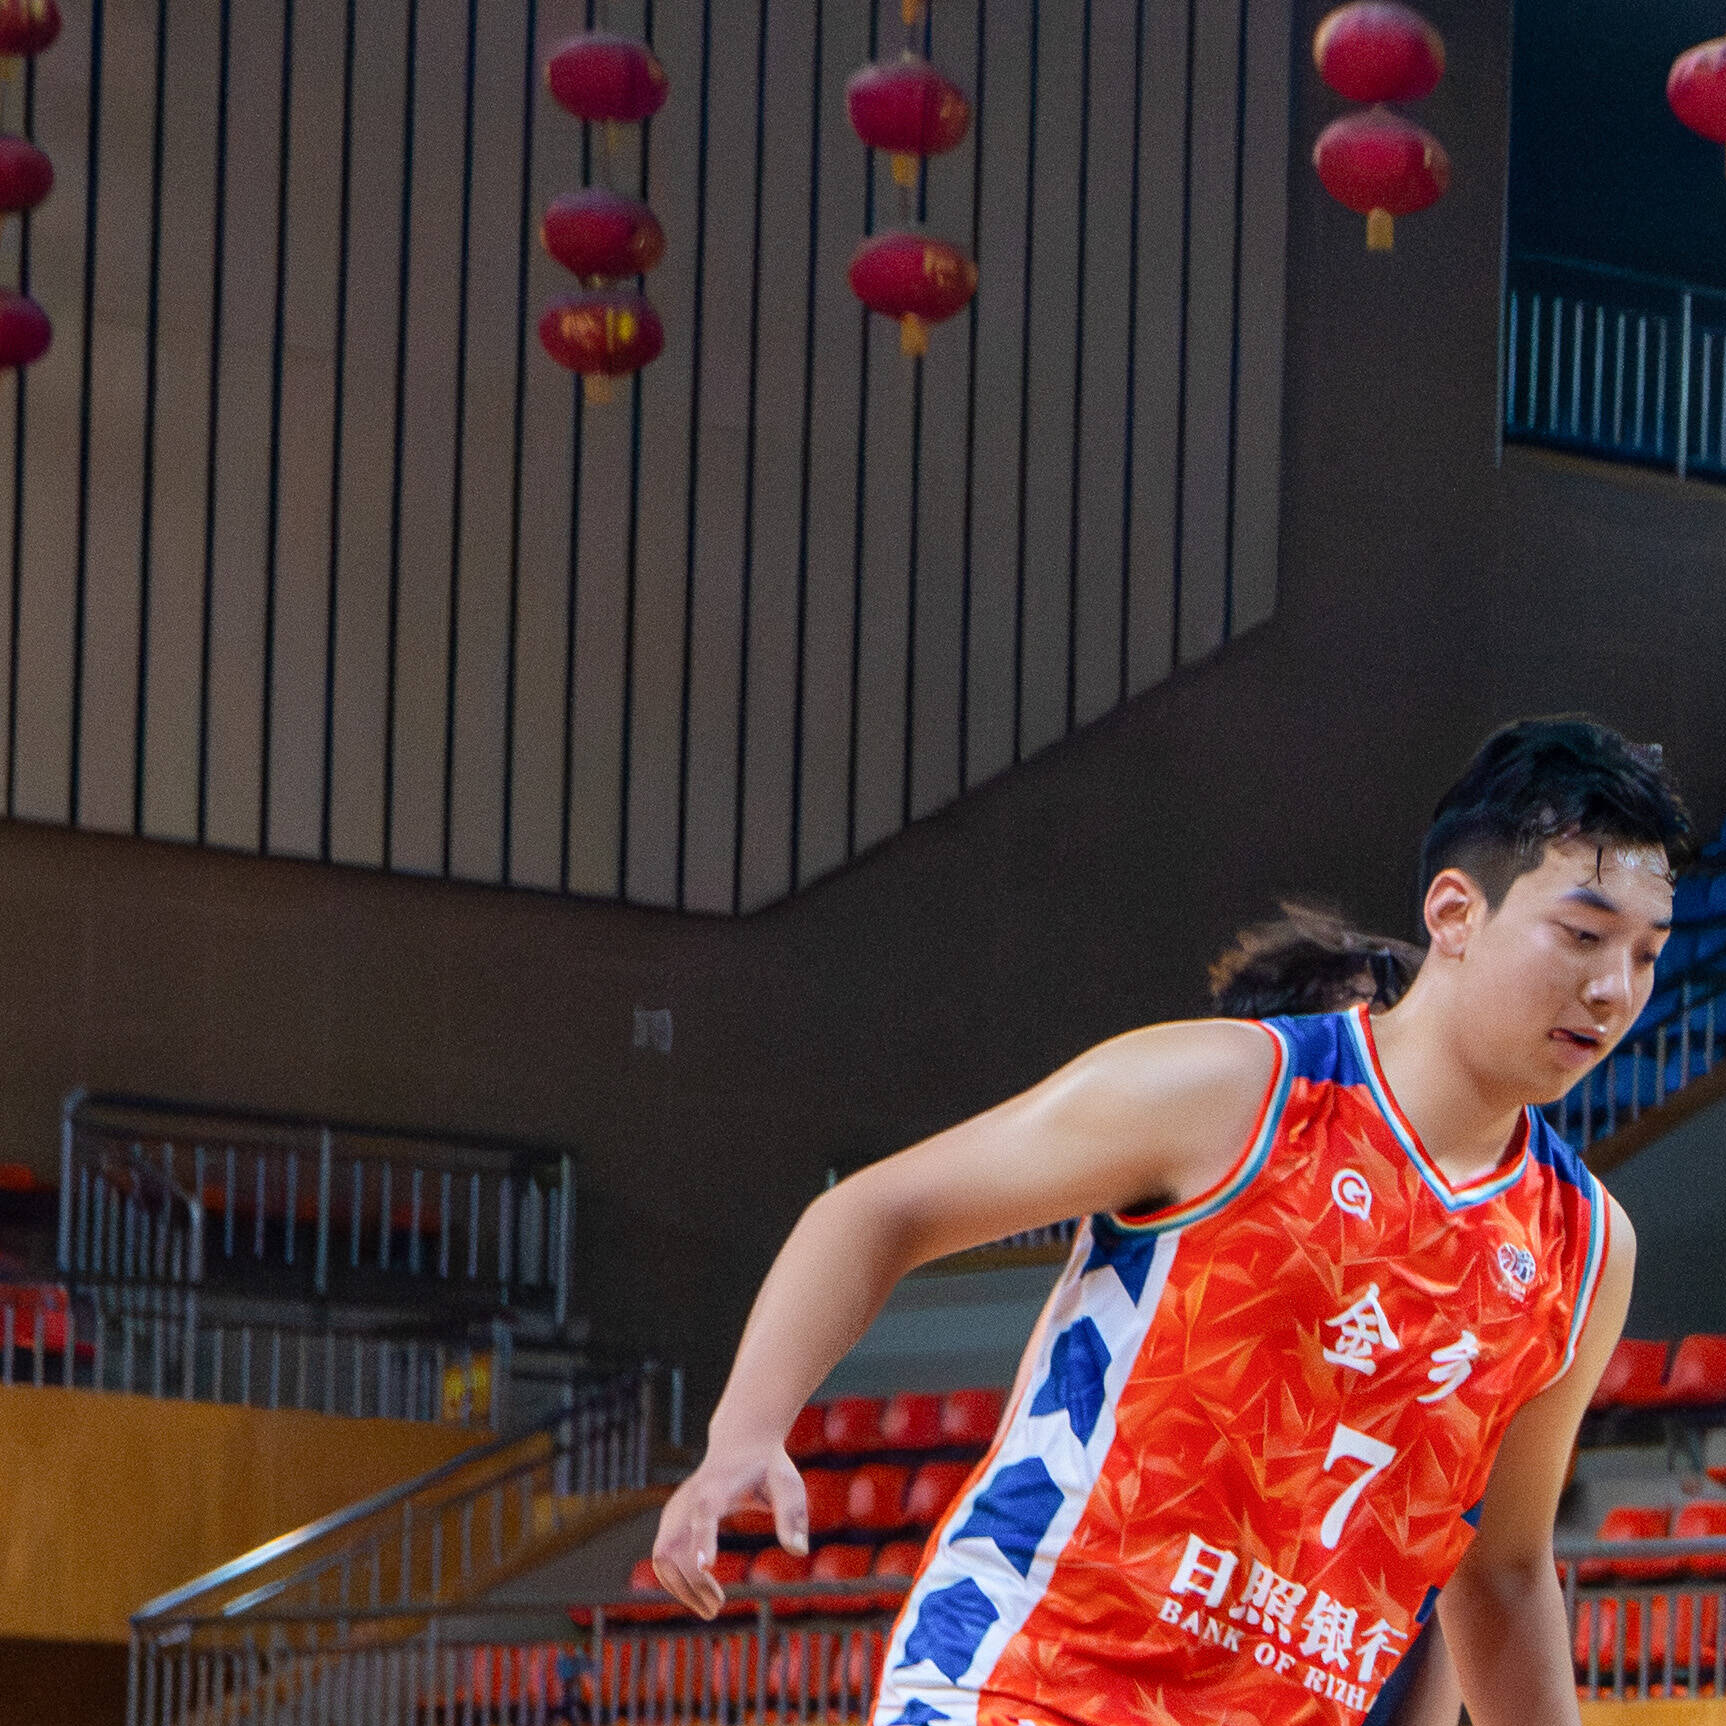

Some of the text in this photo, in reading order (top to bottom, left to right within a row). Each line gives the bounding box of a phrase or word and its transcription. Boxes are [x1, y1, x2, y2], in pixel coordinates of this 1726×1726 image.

[1323, 1283, 1479, 1403] 金乡
[1319, 1425, 1397, 1551] 7
[1158, 1597, 1370, 1712] BANK OF RIZH
[1170, 1532, 1408, 1683] 日照银行
